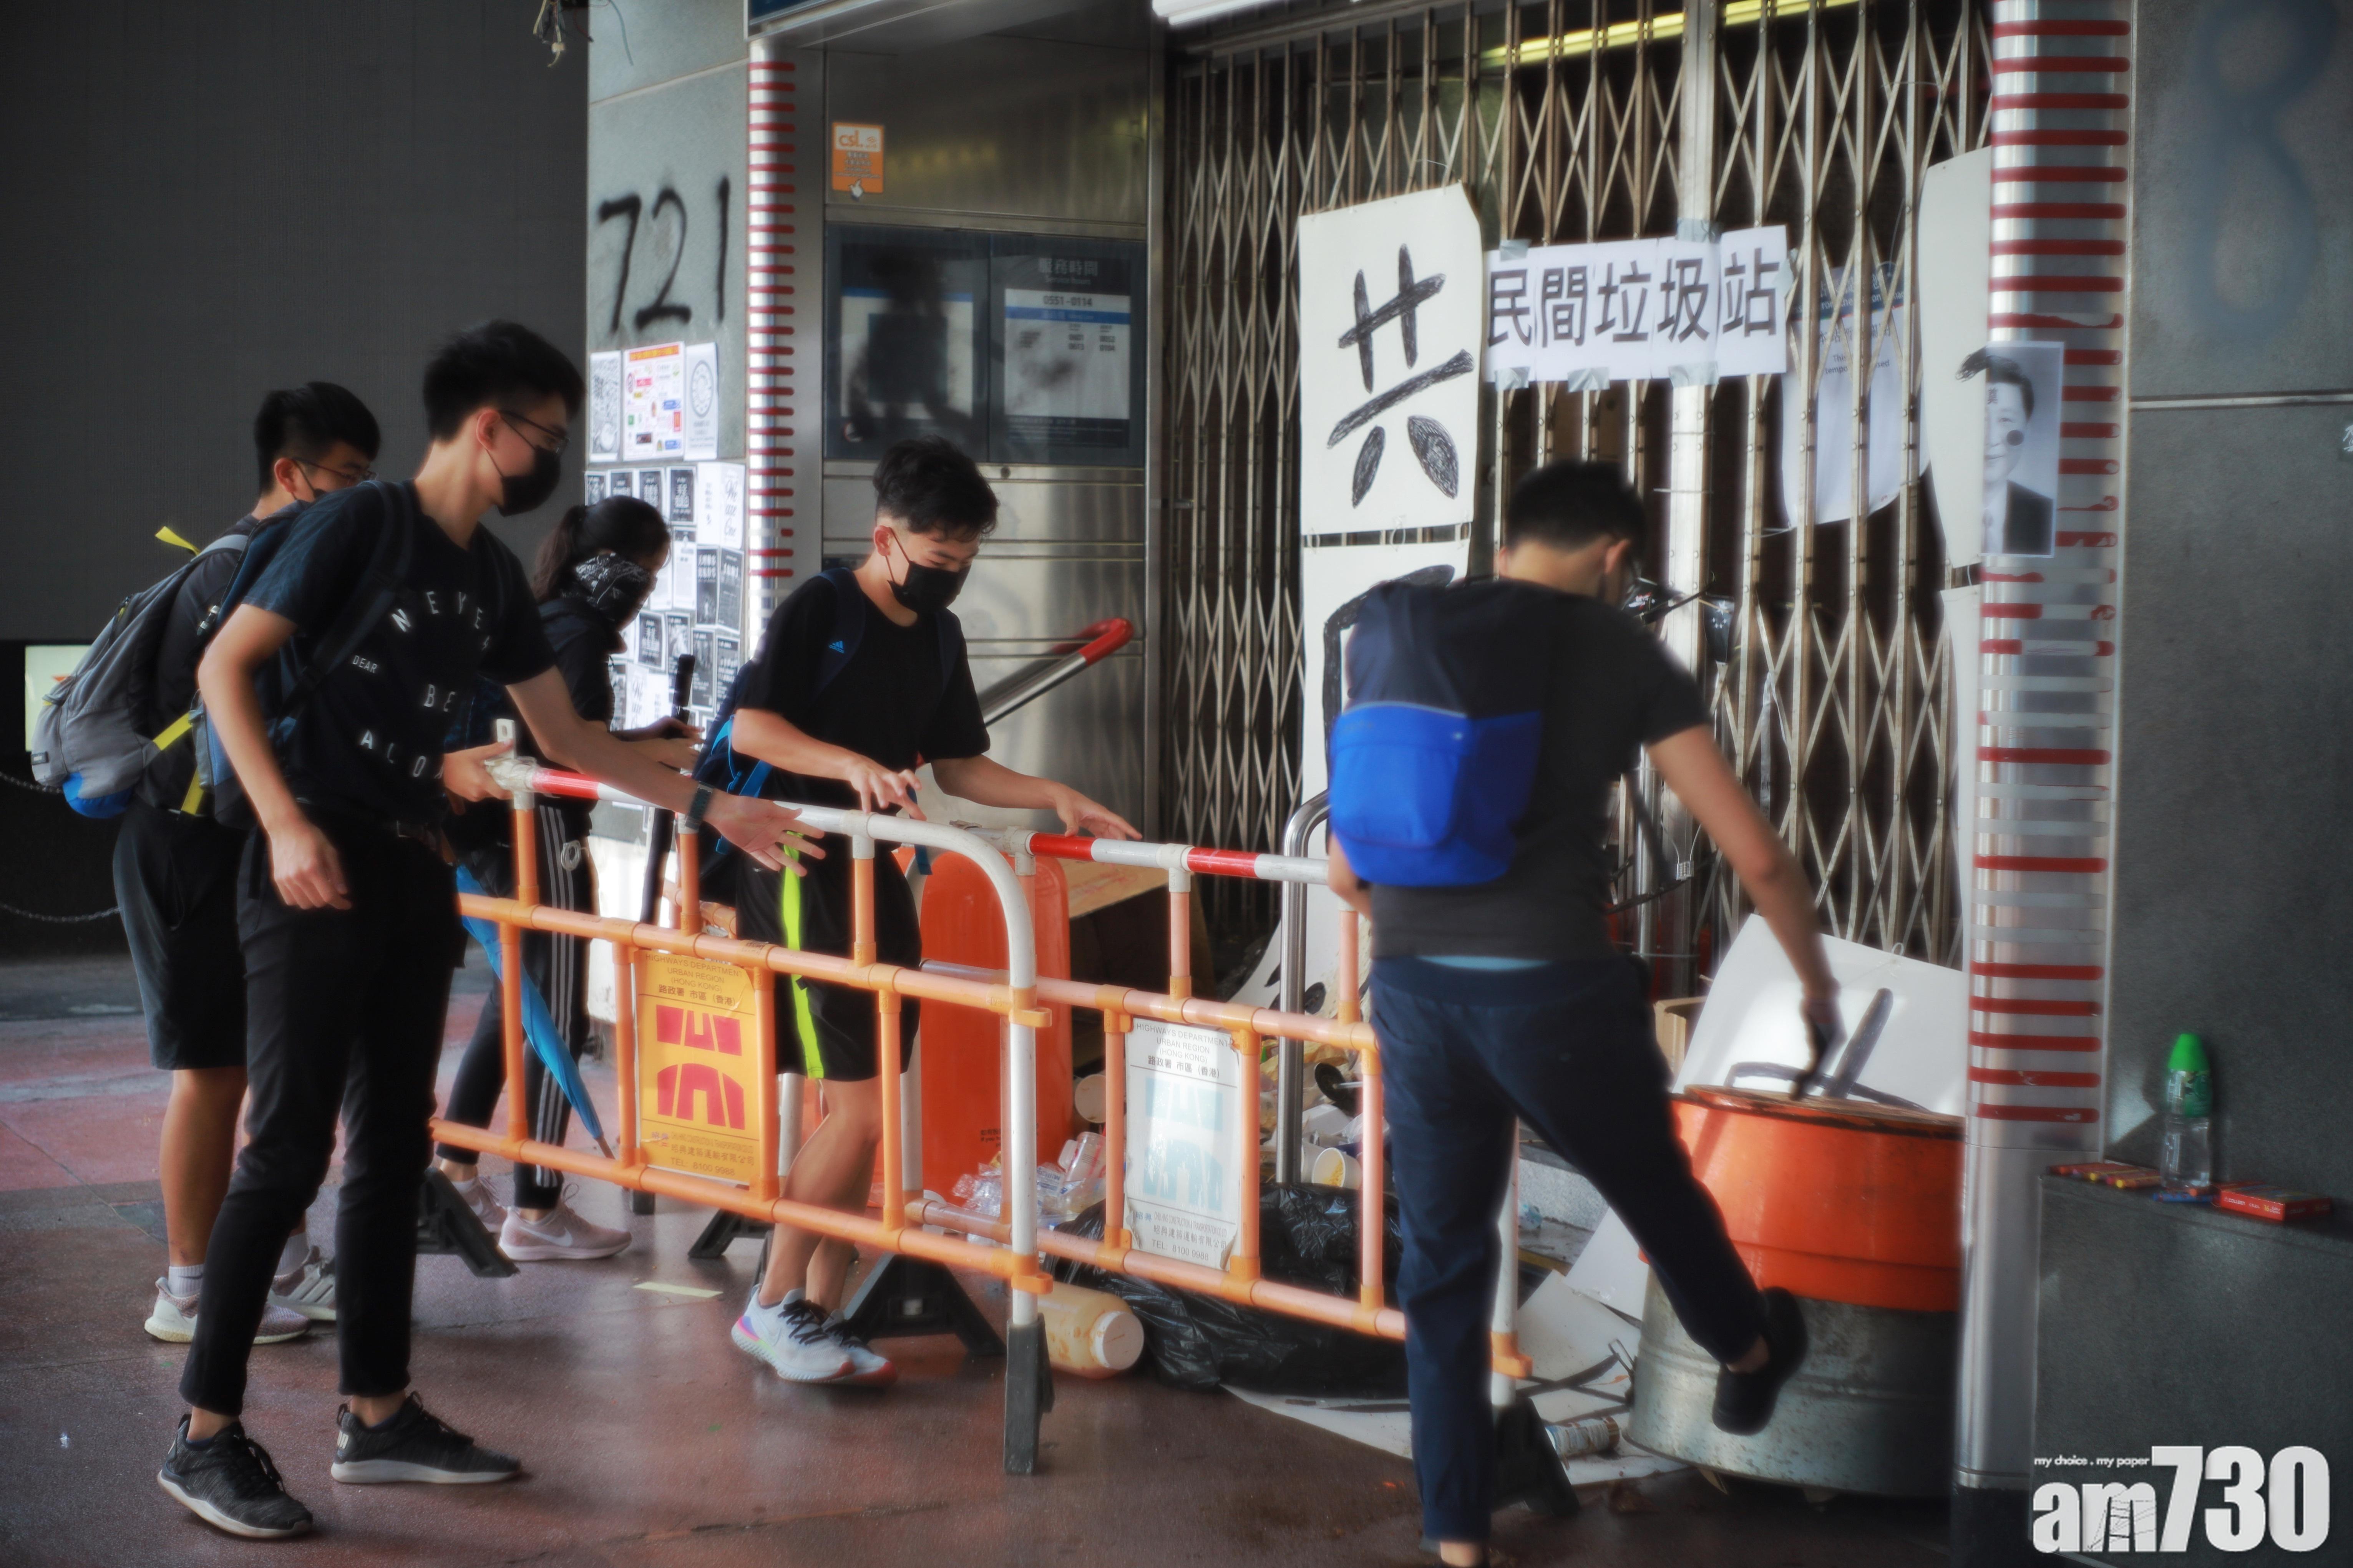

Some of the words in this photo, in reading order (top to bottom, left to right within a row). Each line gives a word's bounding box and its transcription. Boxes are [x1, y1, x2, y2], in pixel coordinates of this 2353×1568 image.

[597, 174, 731, 337] 721
[1488, 247, 1780, 348] 民間垃圾站
[352, 655, 378, 674] DEAR
[423, 684, 456, 713] BE
[645, 954, 689, 967] HIGHWAYS
[691, 961, 743, 978] DEPARTMENT
[667, 967, 694, 978] URBAN
[695, 973, 724, 984] REGION
[659, 984, 685, 997] 路政署
[690, 990, 707, 1001] 市區
[671, 977, 696, 988] (HONG
[698, 983, 723, 994] KONG)
[1137, 1023, 1176, 1037] HIGHWAYS
[1178, 1031, 1229, 1047] DEPARTMENT
[1156, 1037, 1181, 1048] URBAN
[1182, 1043, 1210, 1054] REGION
[1148, 1055, 1172, 1069] 路政署
[1176, 1061, 1193, 1073] 市區
[1159, 1047, 1183, 1058] (HONG
[1184, 1053, 1208, 1064] KONG)
[692, 1161, 713, 1172] 8100
[715, 1165, 735, 1176] 9988
[1152, 1239, 1168, 1250] TEL:
[1172, 1244, 1190, 1256] 8100
[1191, 1250, 1209, 1261] 9988
